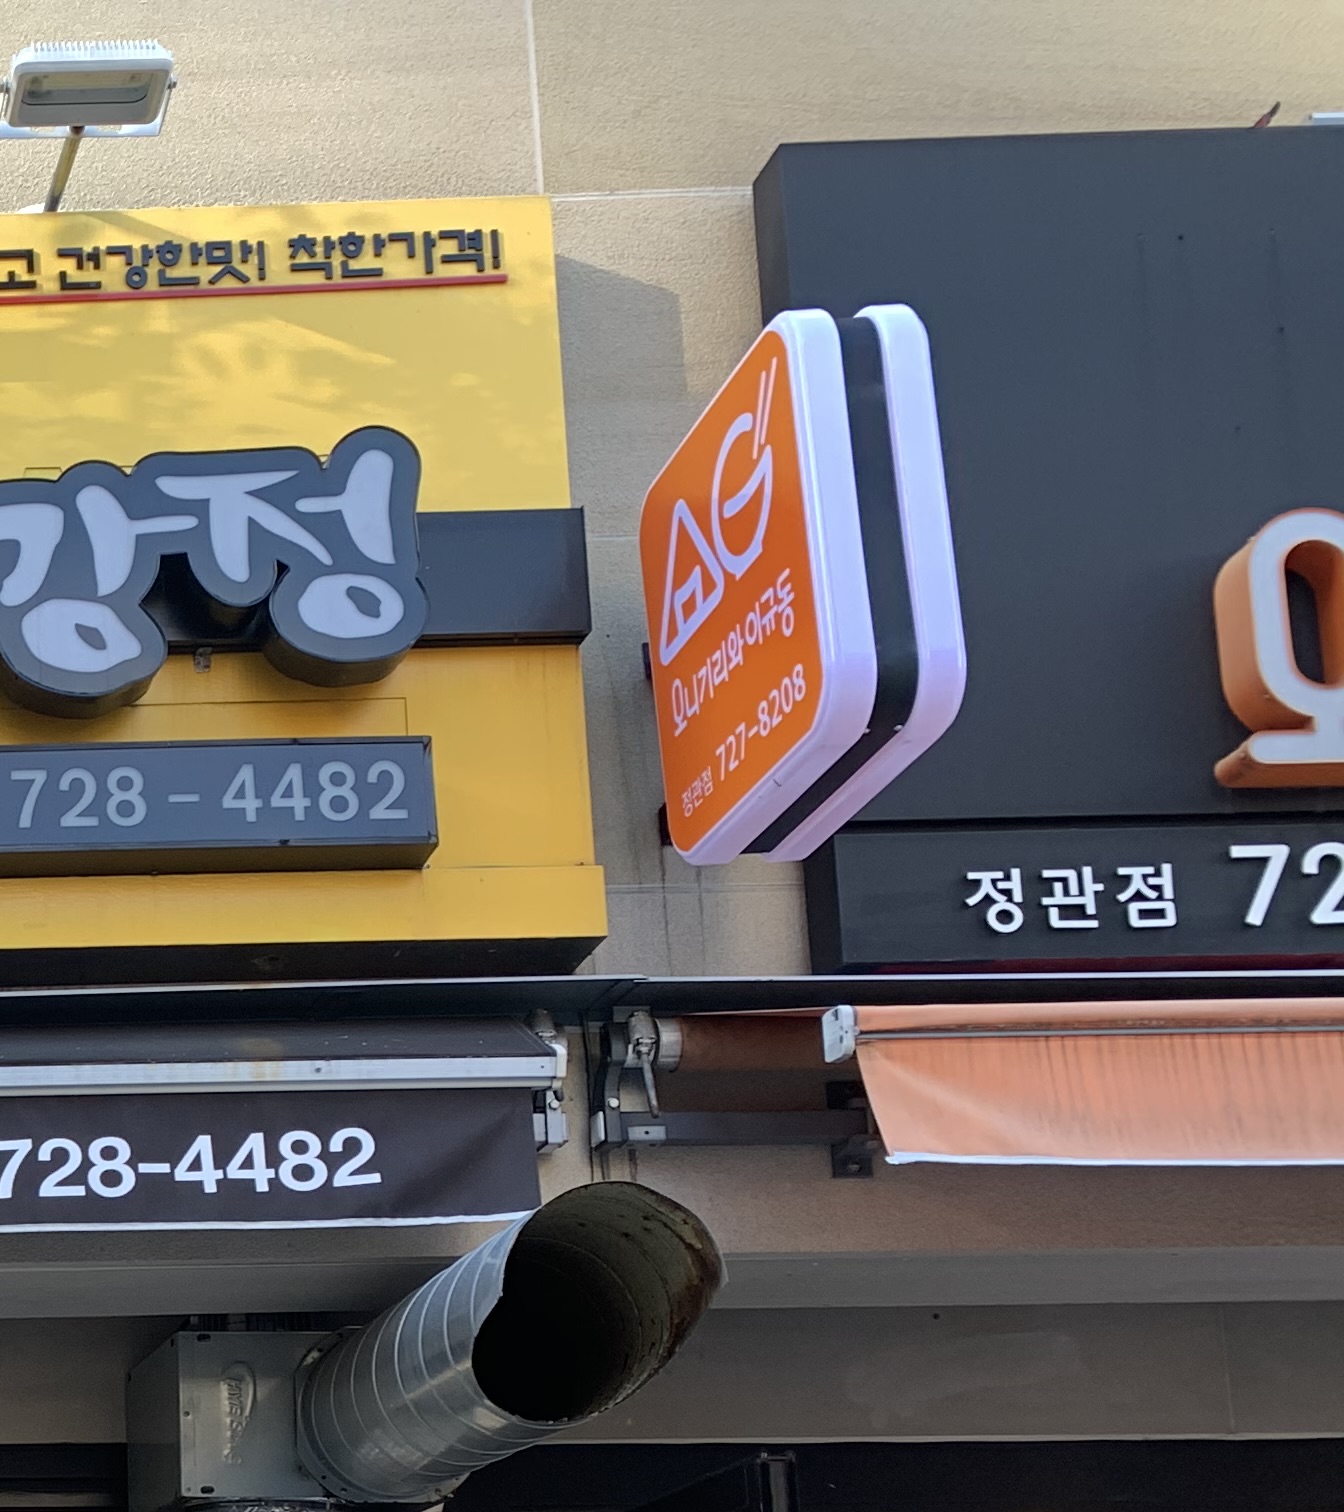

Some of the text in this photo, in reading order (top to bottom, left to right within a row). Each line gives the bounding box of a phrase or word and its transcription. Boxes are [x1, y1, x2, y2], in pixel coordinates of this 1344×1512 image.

[58, 239, 266, 292] 건강한맛!
[288, 228, 502, 281] 착한가격!
[681, 663, 806, 818] 정관점 727-8208
[965, 862, 1178, 933] 정관점
